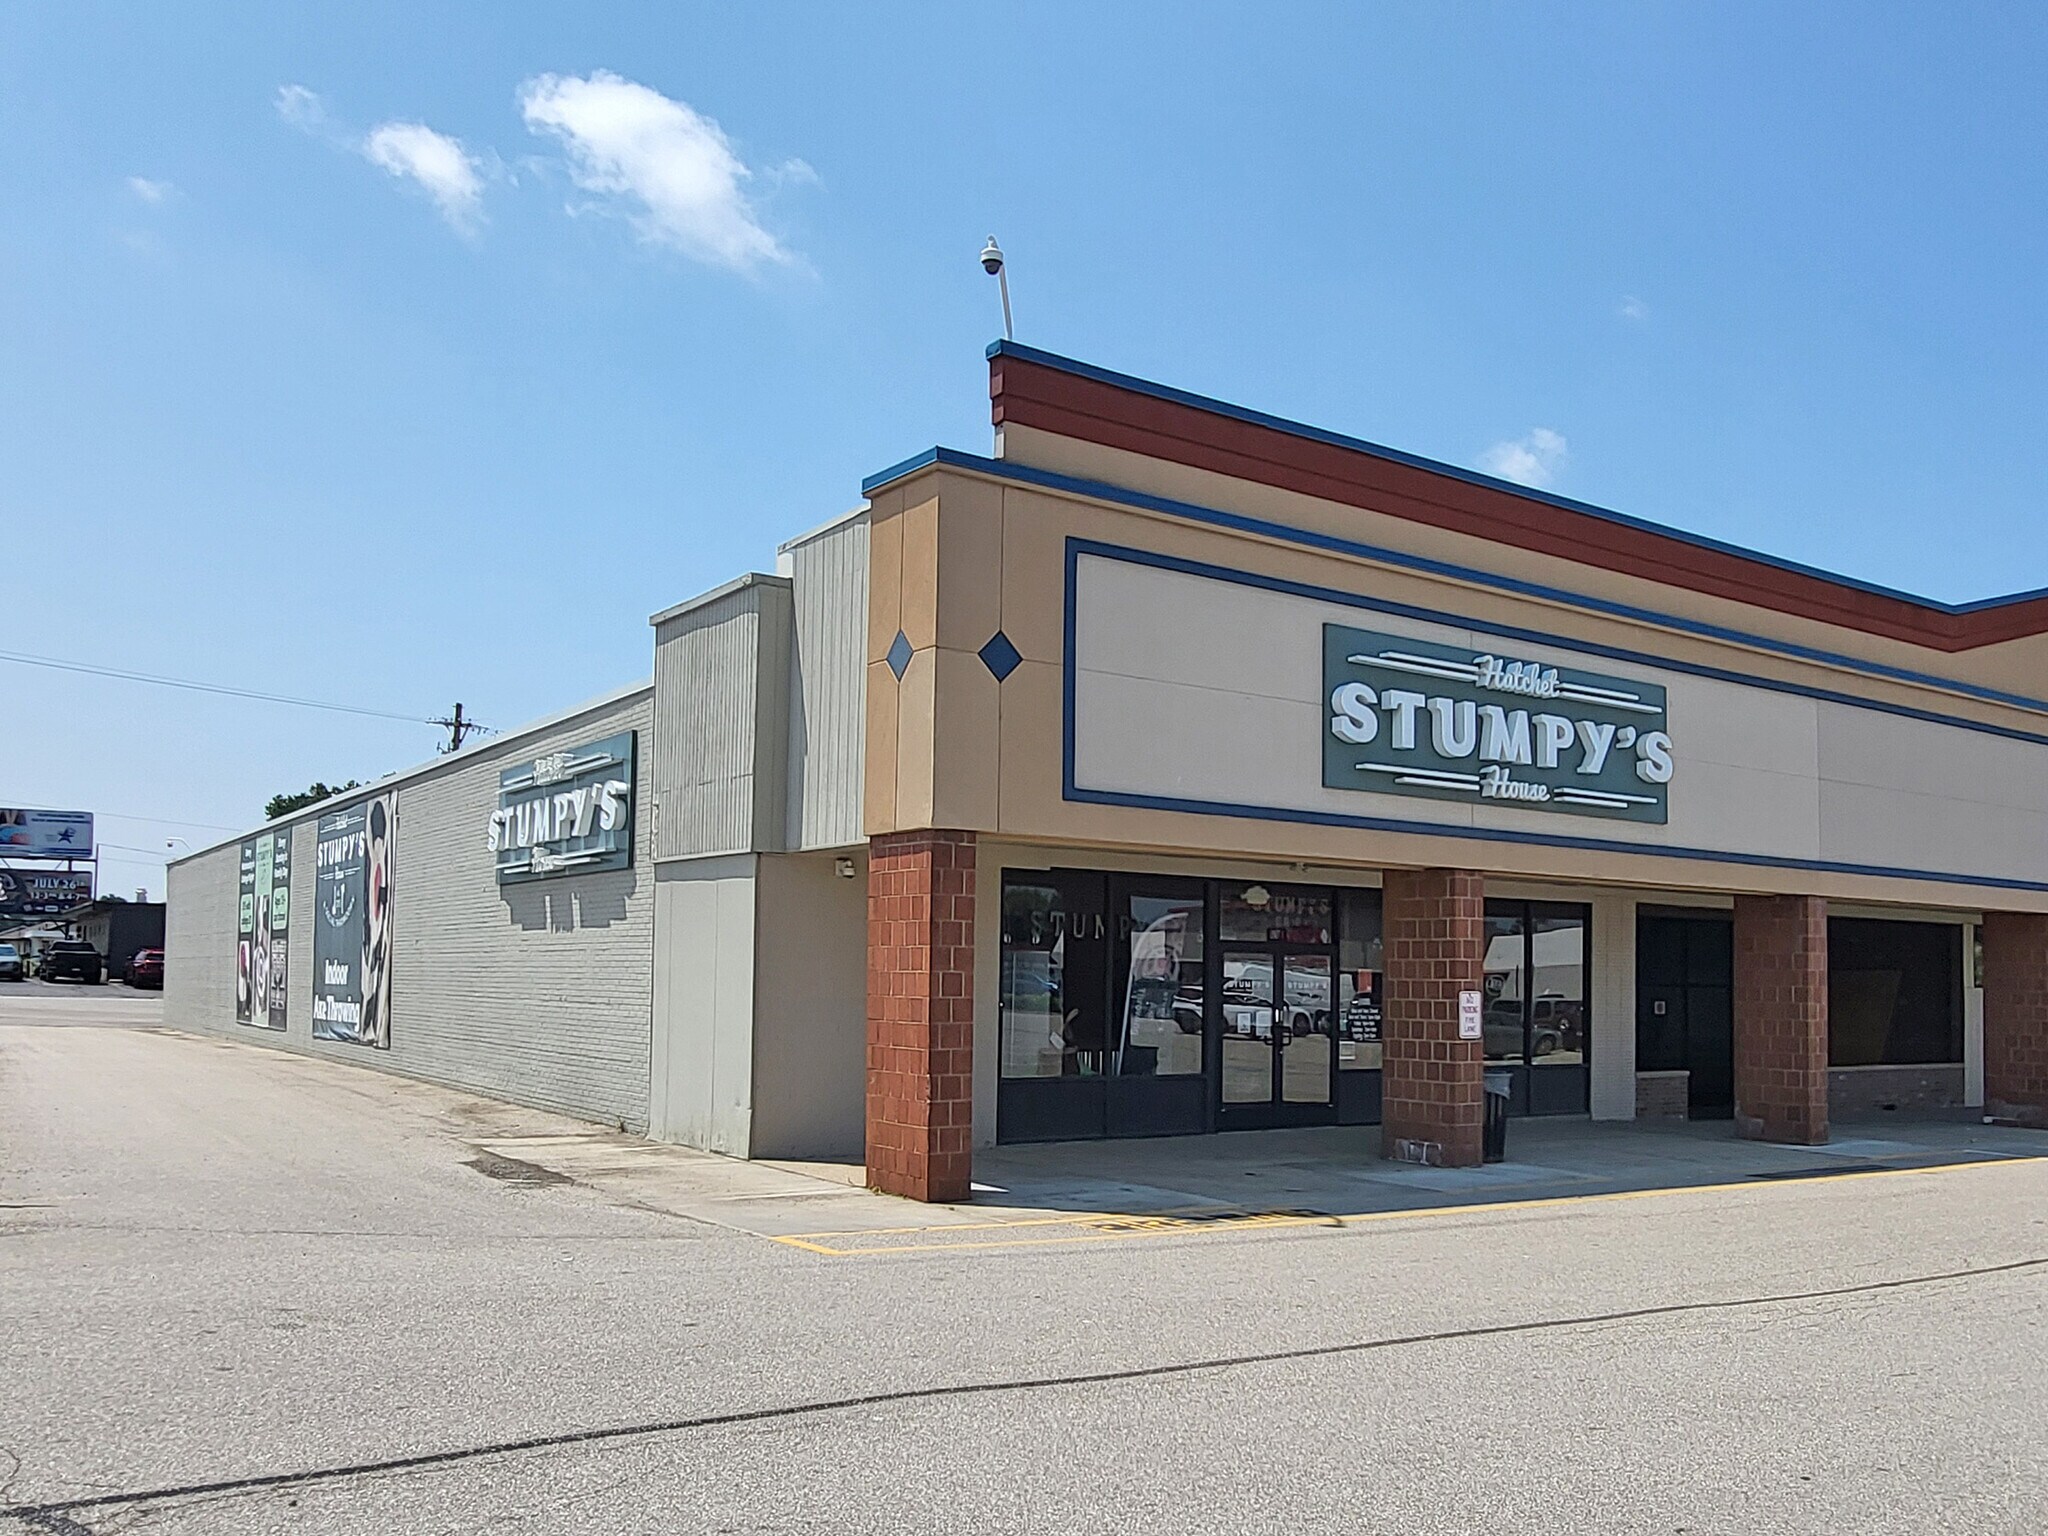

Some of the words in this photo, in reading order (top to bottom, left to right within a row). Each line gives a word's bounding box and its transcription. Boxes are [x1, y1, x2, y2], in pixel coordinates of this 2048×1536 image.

[1473, 654, 1560, 699] Hatchet
[1331, 682, 1674, 784] STUMPY'S
[1480, 764, 1551, 801] House
[487, 779, 628, 852] STUMPY'S
[317, 830, 366, 868] STUMPY'S
[33, 878, 60, 889] JULY
[325, 959, 349, 985] Indoor
[313, 994, 327, 1020] Axe
[326, 995, 360, 1033] Throwing
